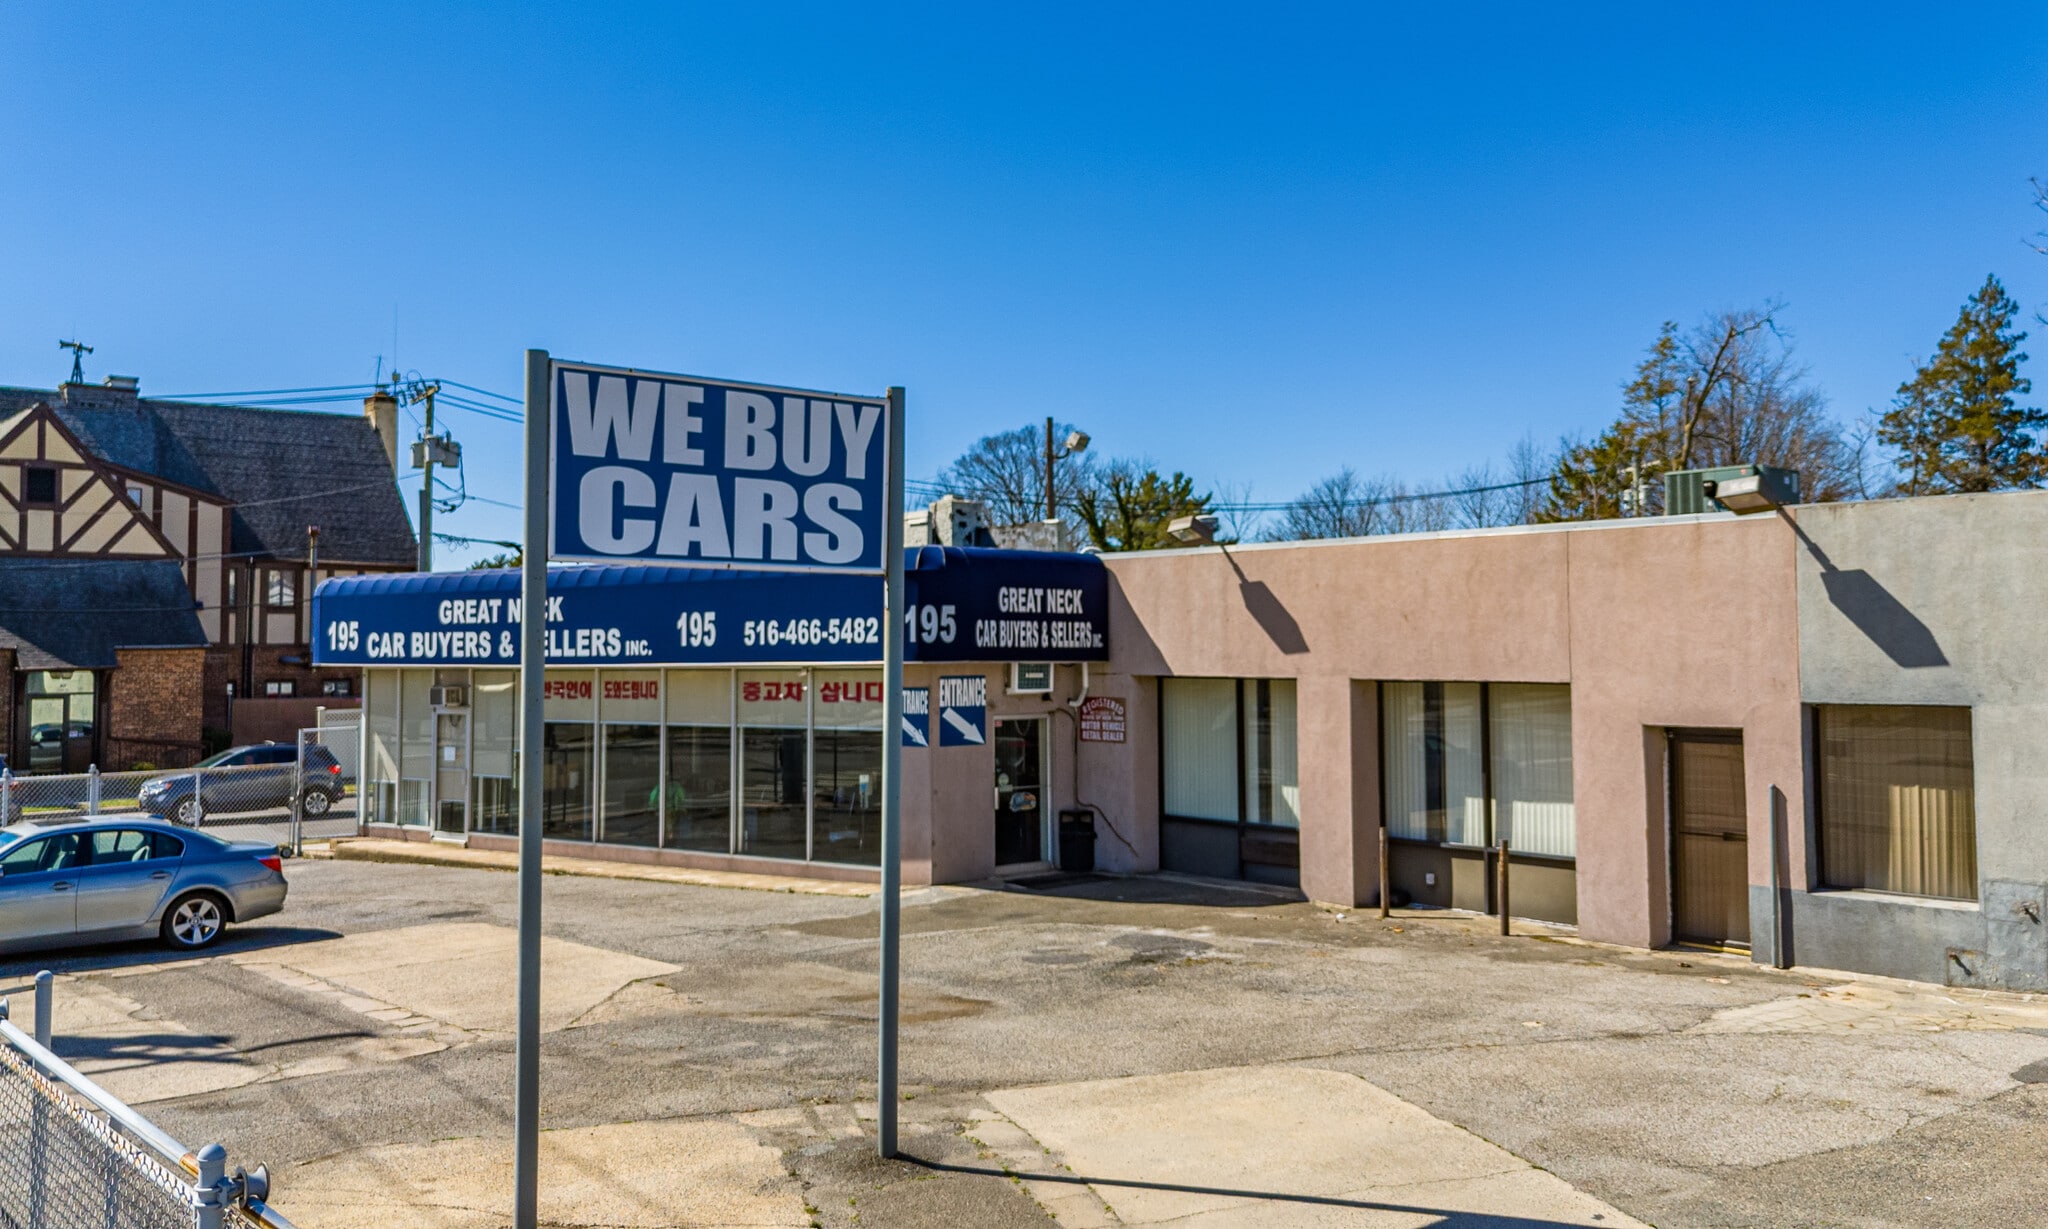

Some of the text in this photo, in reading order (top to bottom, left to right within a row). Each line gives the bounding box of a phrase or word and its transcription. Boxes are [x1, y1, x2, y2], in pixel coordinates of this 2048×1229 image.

[563, 371, 881, 479] WE BUY
[579, 465, 864, 565] CARS
[438, 596, 564, 625] GREAT NK
[998, 586, 1083, 614] GREAT NECK
[328, 620, 359, 651] 195
[677, 610, 717, 647] 195
[743, 616, 879, 647] 516-466-5482
[904, 604, 957, 643] 195
[975, 618, 998, 648] CAR
[999, 619, 1039, 648] BUYERS
[1041, 620, 1049, 648] &
[1050, 621, 1092, 649] SELLERS
[367, 627, 653, 658] CAR BUYERS & LLERS INC.
[743, 681, 802, 702] 중고차
[902, 690, 929, 715] TRANCE
[940, 678, 987, 707] ENTRANCE
[1082, 697, 1124, 715] REGISTERED
